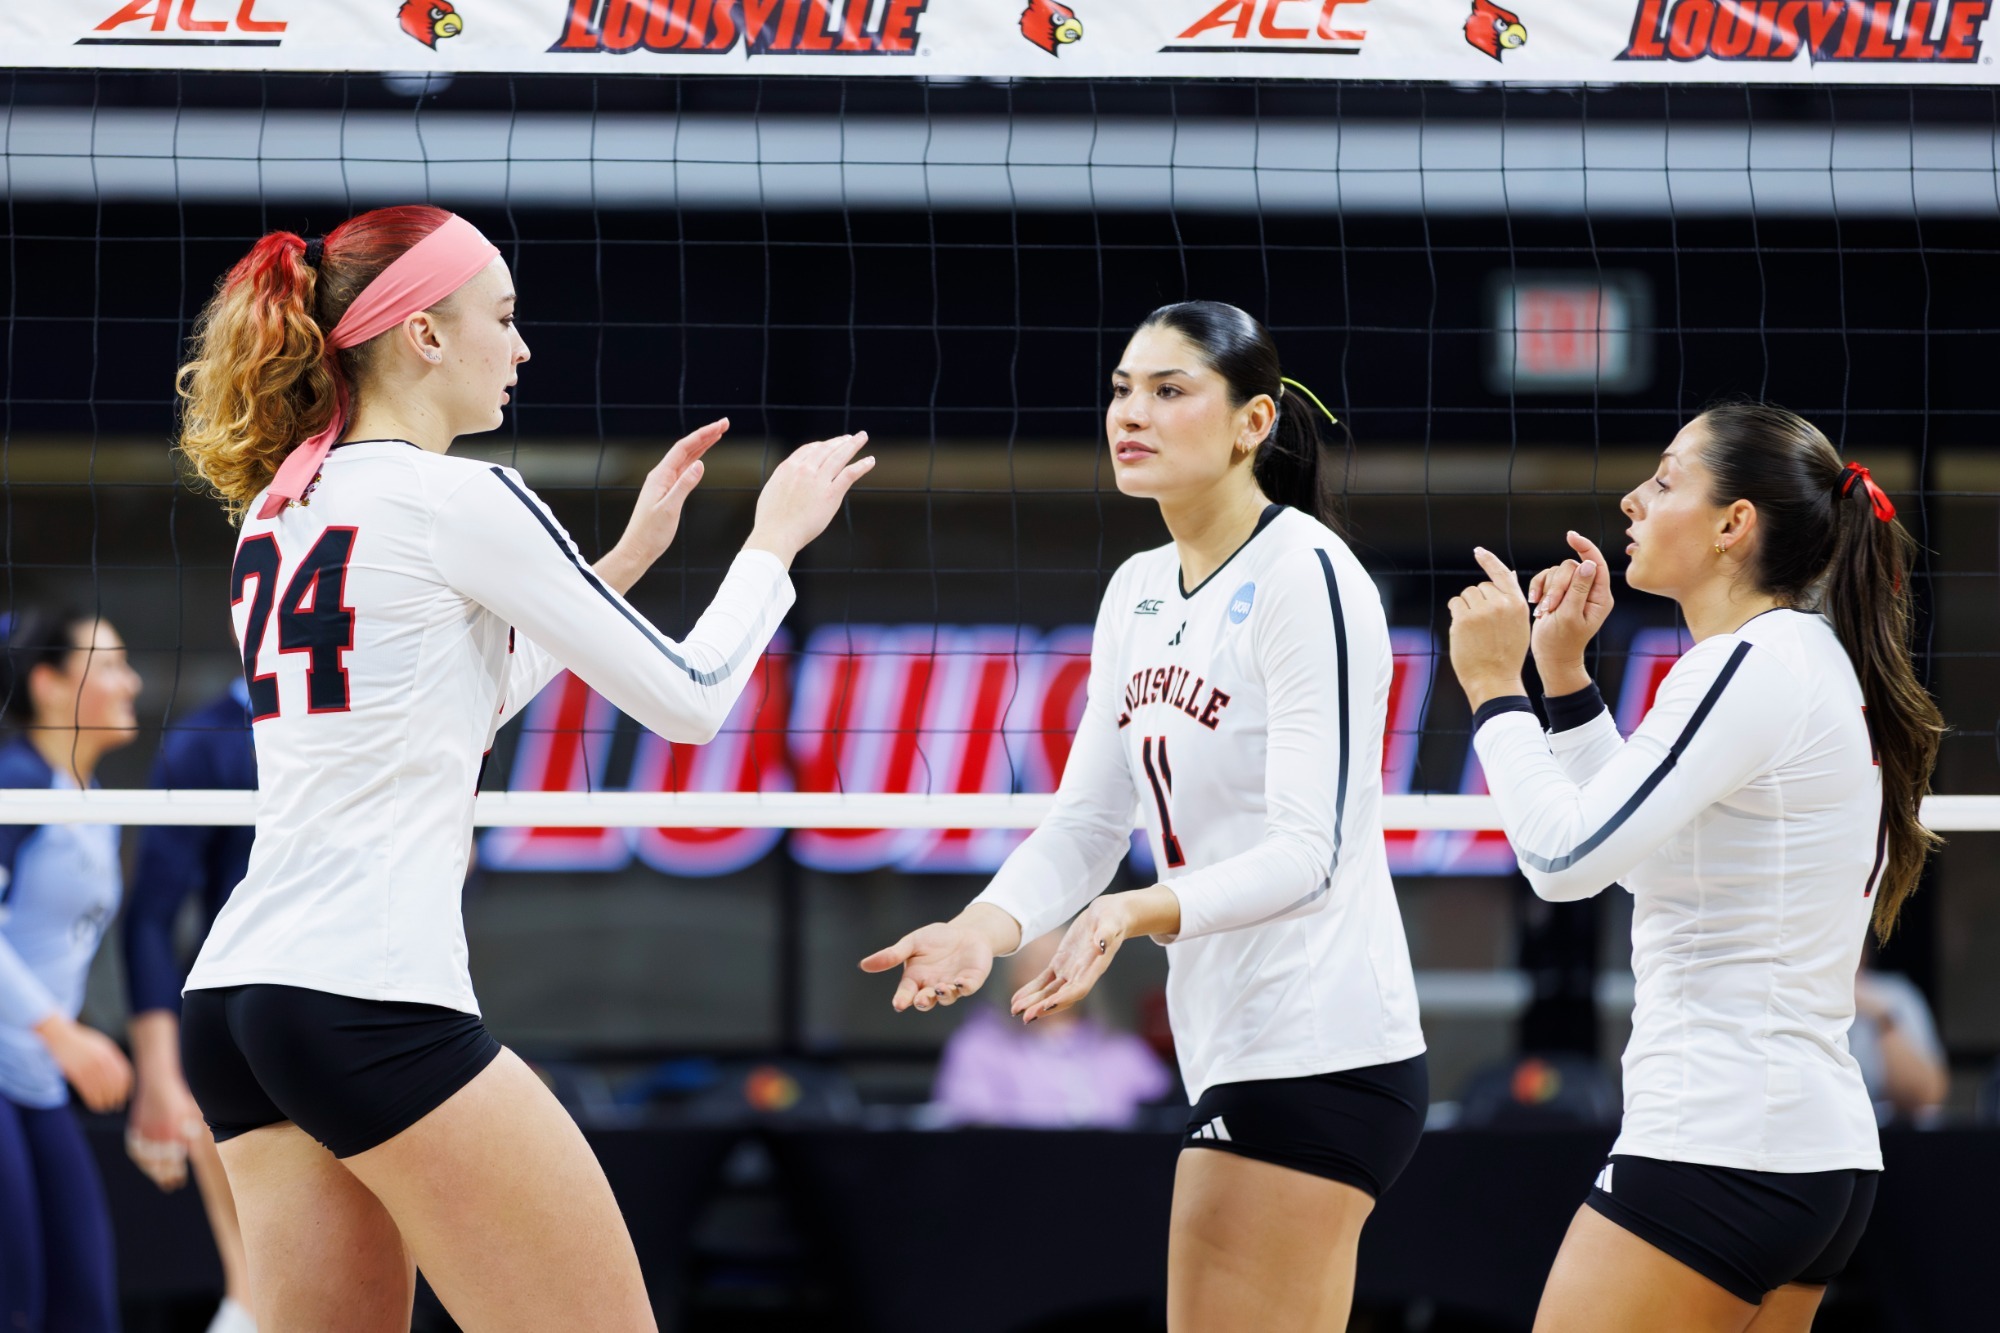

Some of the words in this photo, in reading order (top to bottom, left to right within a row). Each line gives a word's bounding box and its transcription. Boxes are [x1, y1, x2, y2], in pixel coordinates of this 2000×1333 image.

[93, 0, 288, 32] ACC
[545, 0, 925, 60] LOUISVILLE
[1176, 0, 1367, 41] ACC
[1613, 0, 1989, 68] LOUISVILLE
[230, 525, 359, 724] 24
[1135, 599, 1165, 612] ACC
